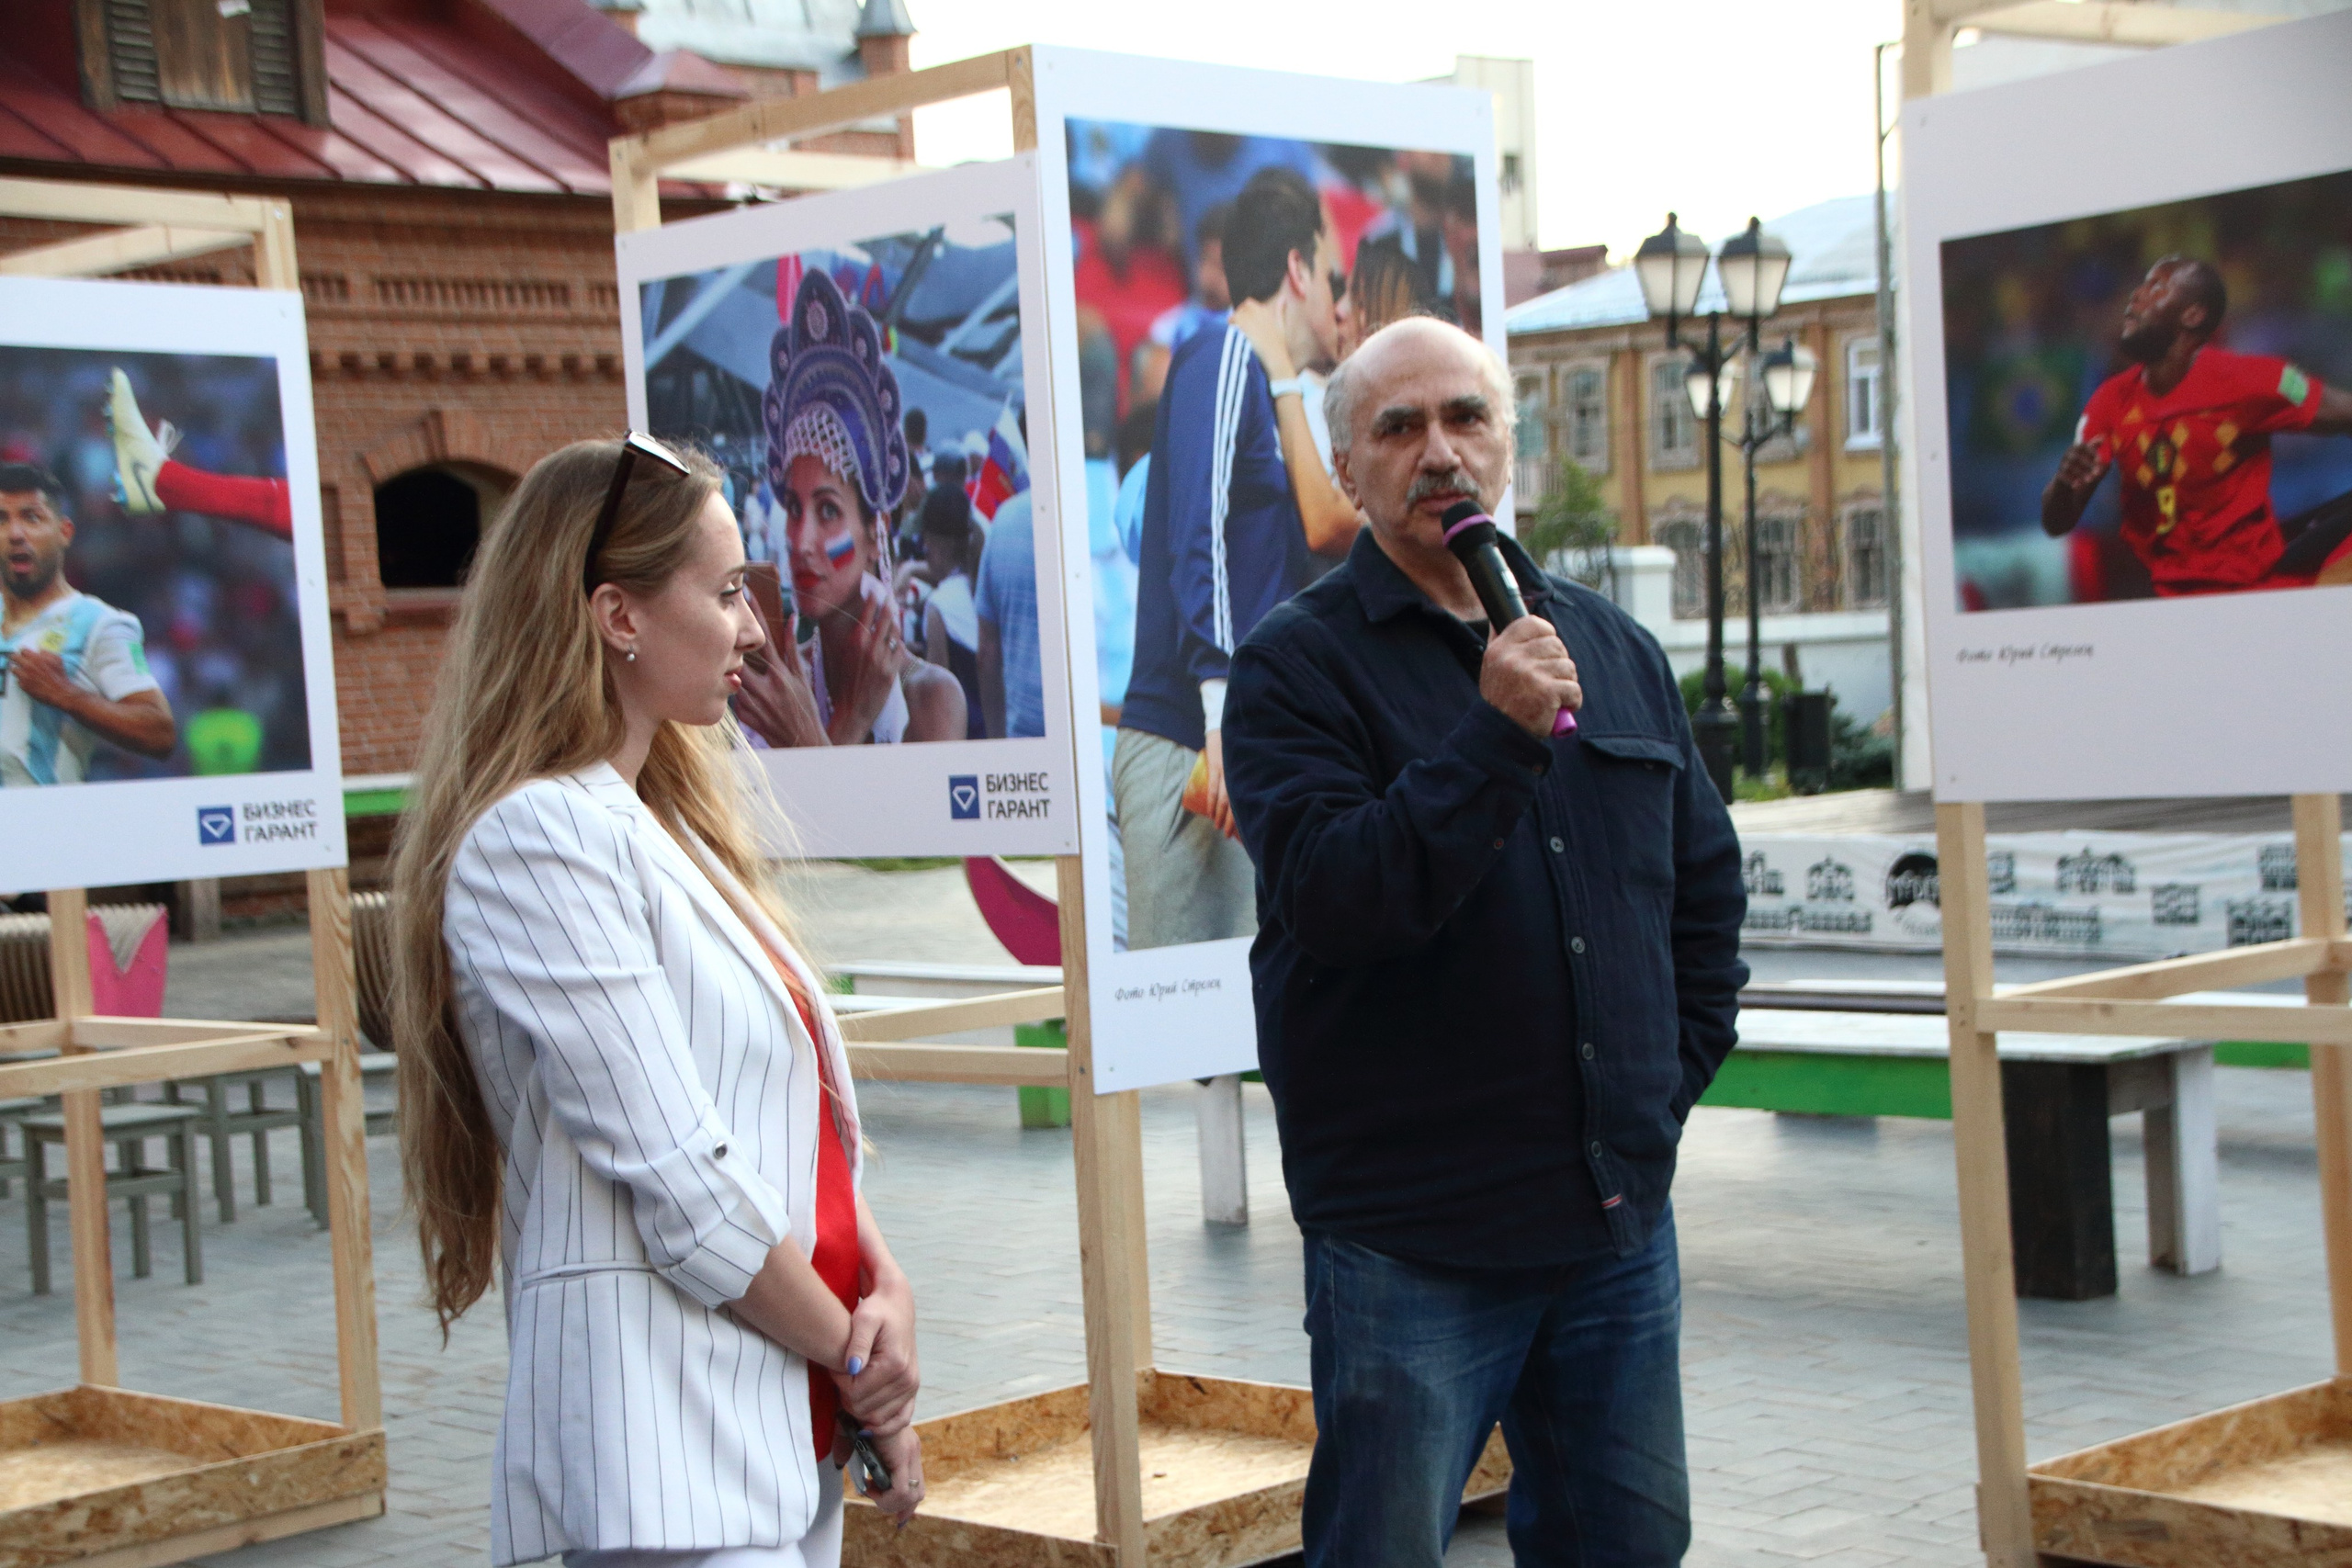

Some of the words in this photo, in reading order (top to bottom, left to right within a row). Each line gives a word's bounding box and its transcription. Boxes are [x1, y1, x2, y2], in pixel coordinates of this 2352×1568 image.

[986, 773, 1048, 793] БИЗНЕС
[243, 798, 316, 821] БИЗНЕС
[988, 798, 1050, 818] ГАРАНТ
[244, 821, 318, 842] ГАРАНТ
[1114, 987, 1145, 1001] Фото
[1148, 981, 1177, 1001] Юрий
[1182, 978, 1222, 997] Стрелец
